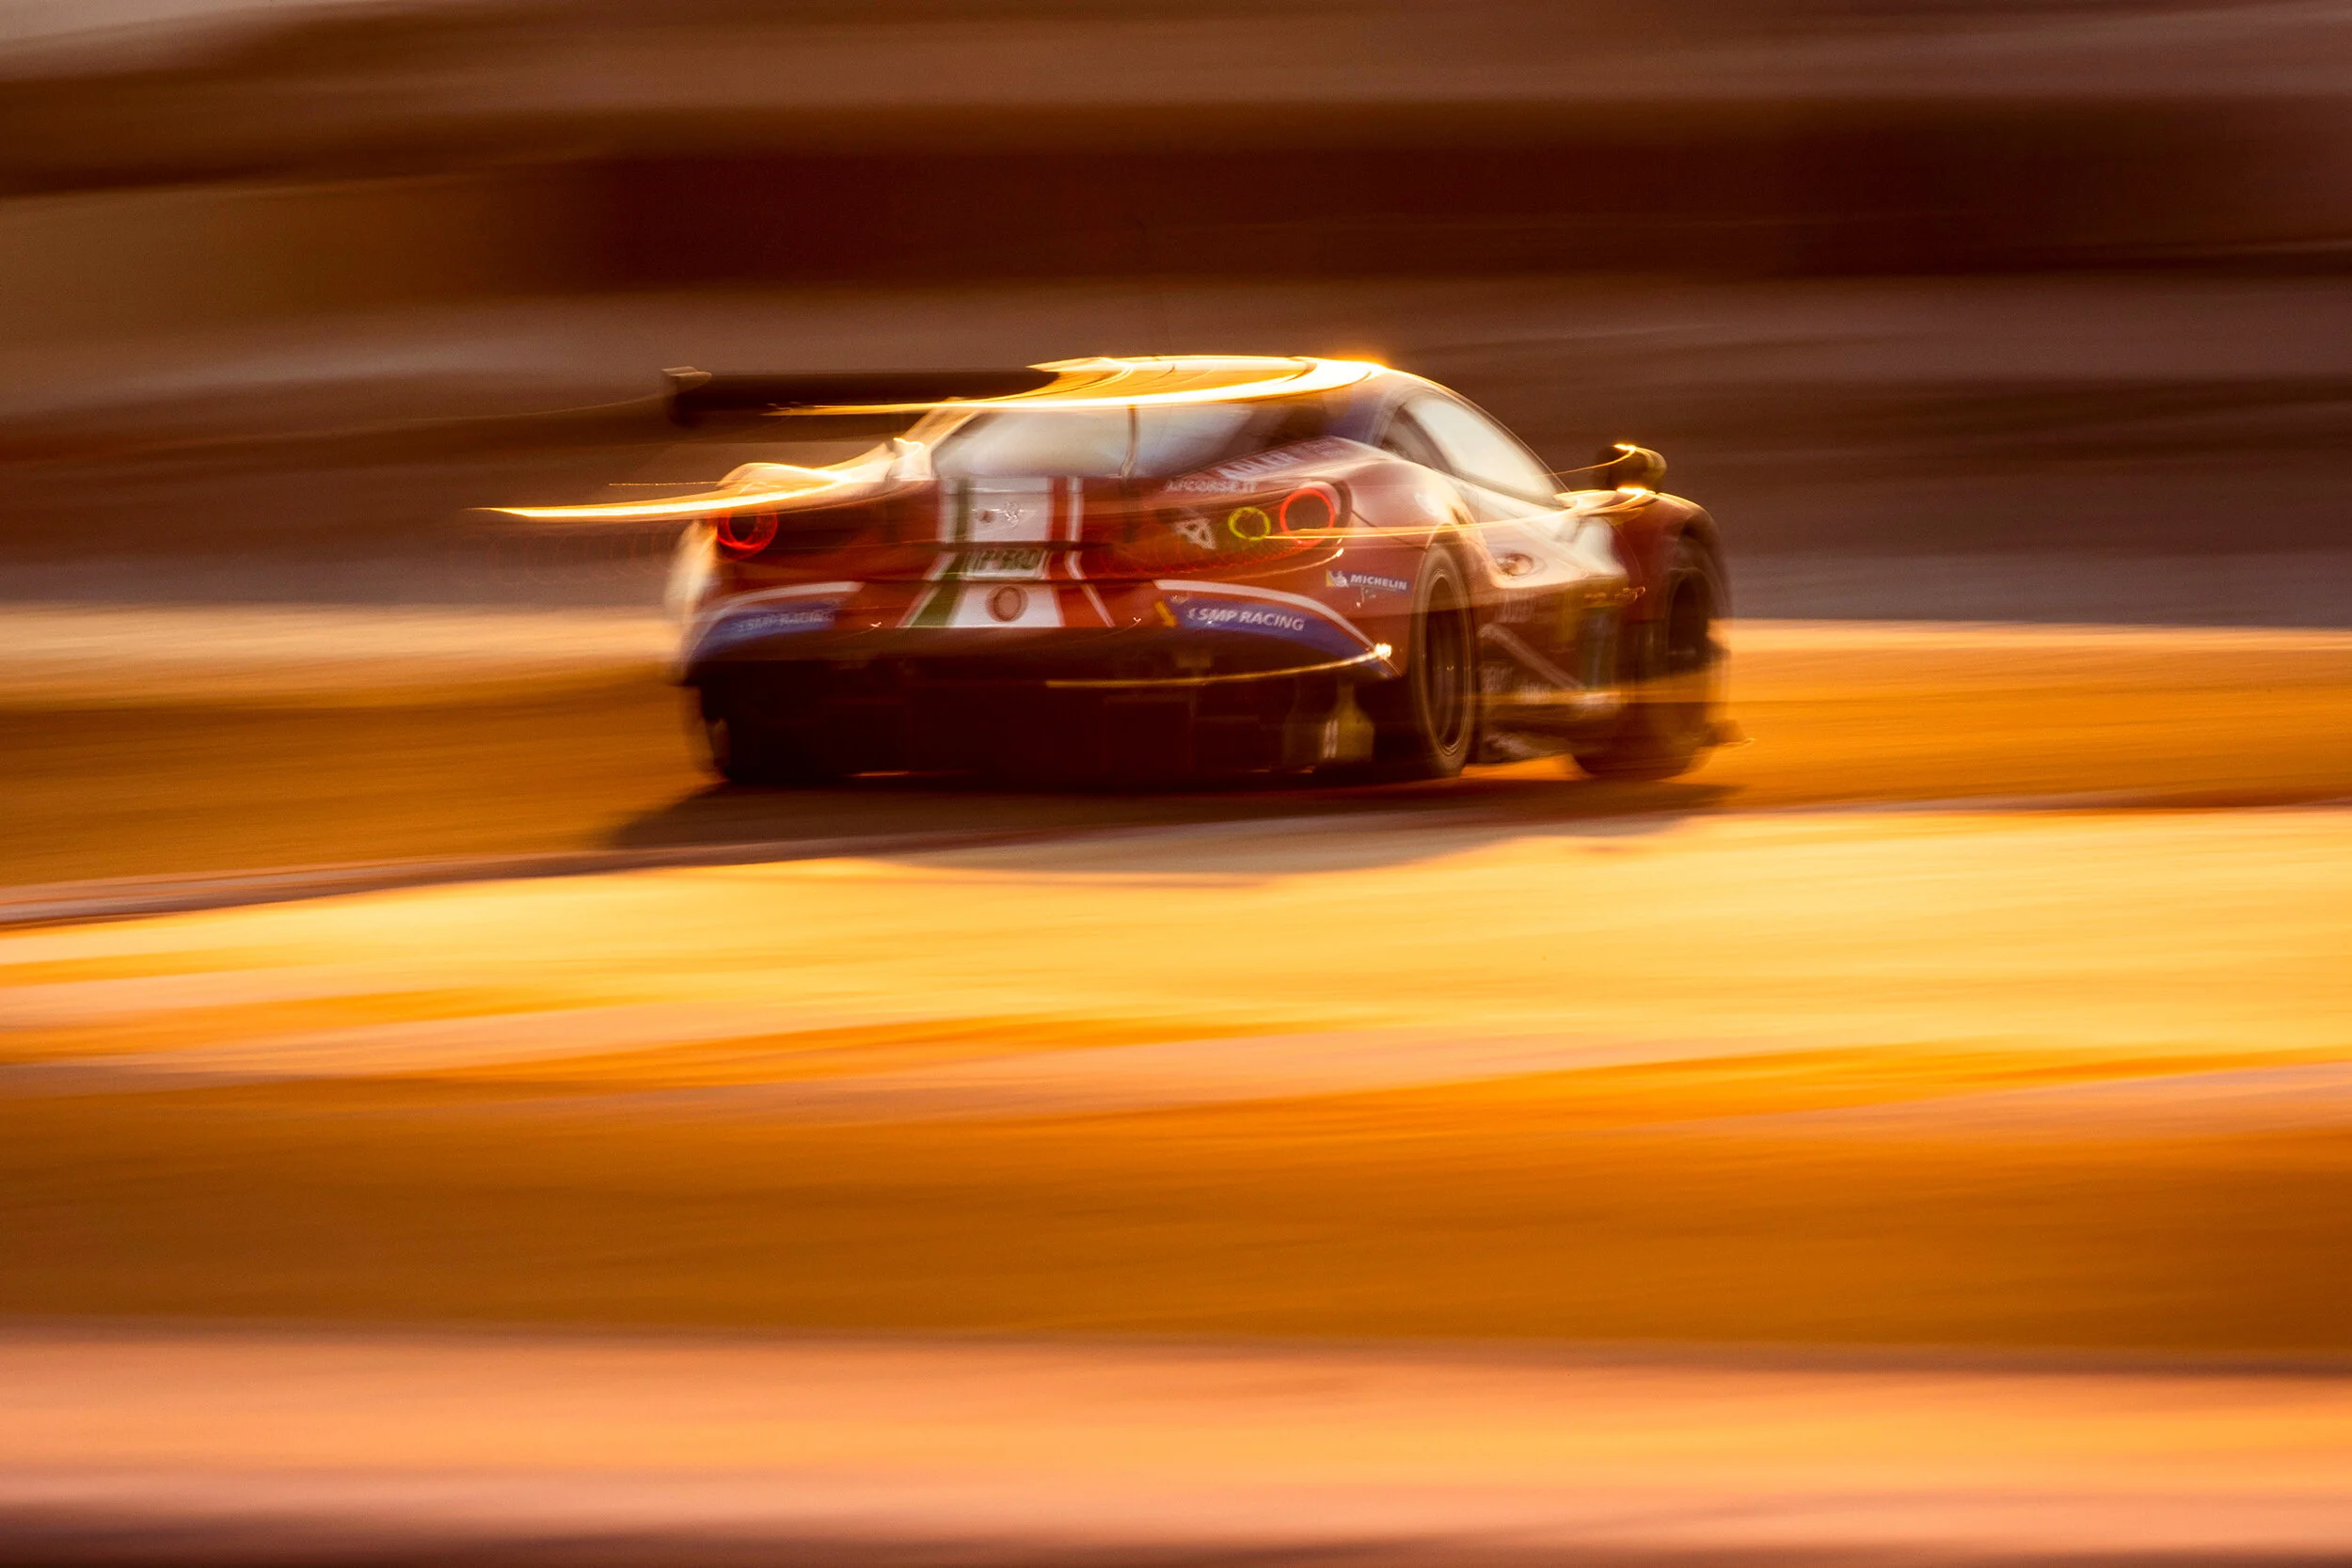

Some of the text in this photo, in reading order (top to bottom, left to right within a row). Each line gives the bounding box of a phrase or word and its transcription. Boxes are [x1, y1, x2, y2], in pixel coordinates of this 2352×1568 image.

[1350, 574, 1407, 591] MICHELIN
[1198, 608, 1306, 631] SMP RACING
